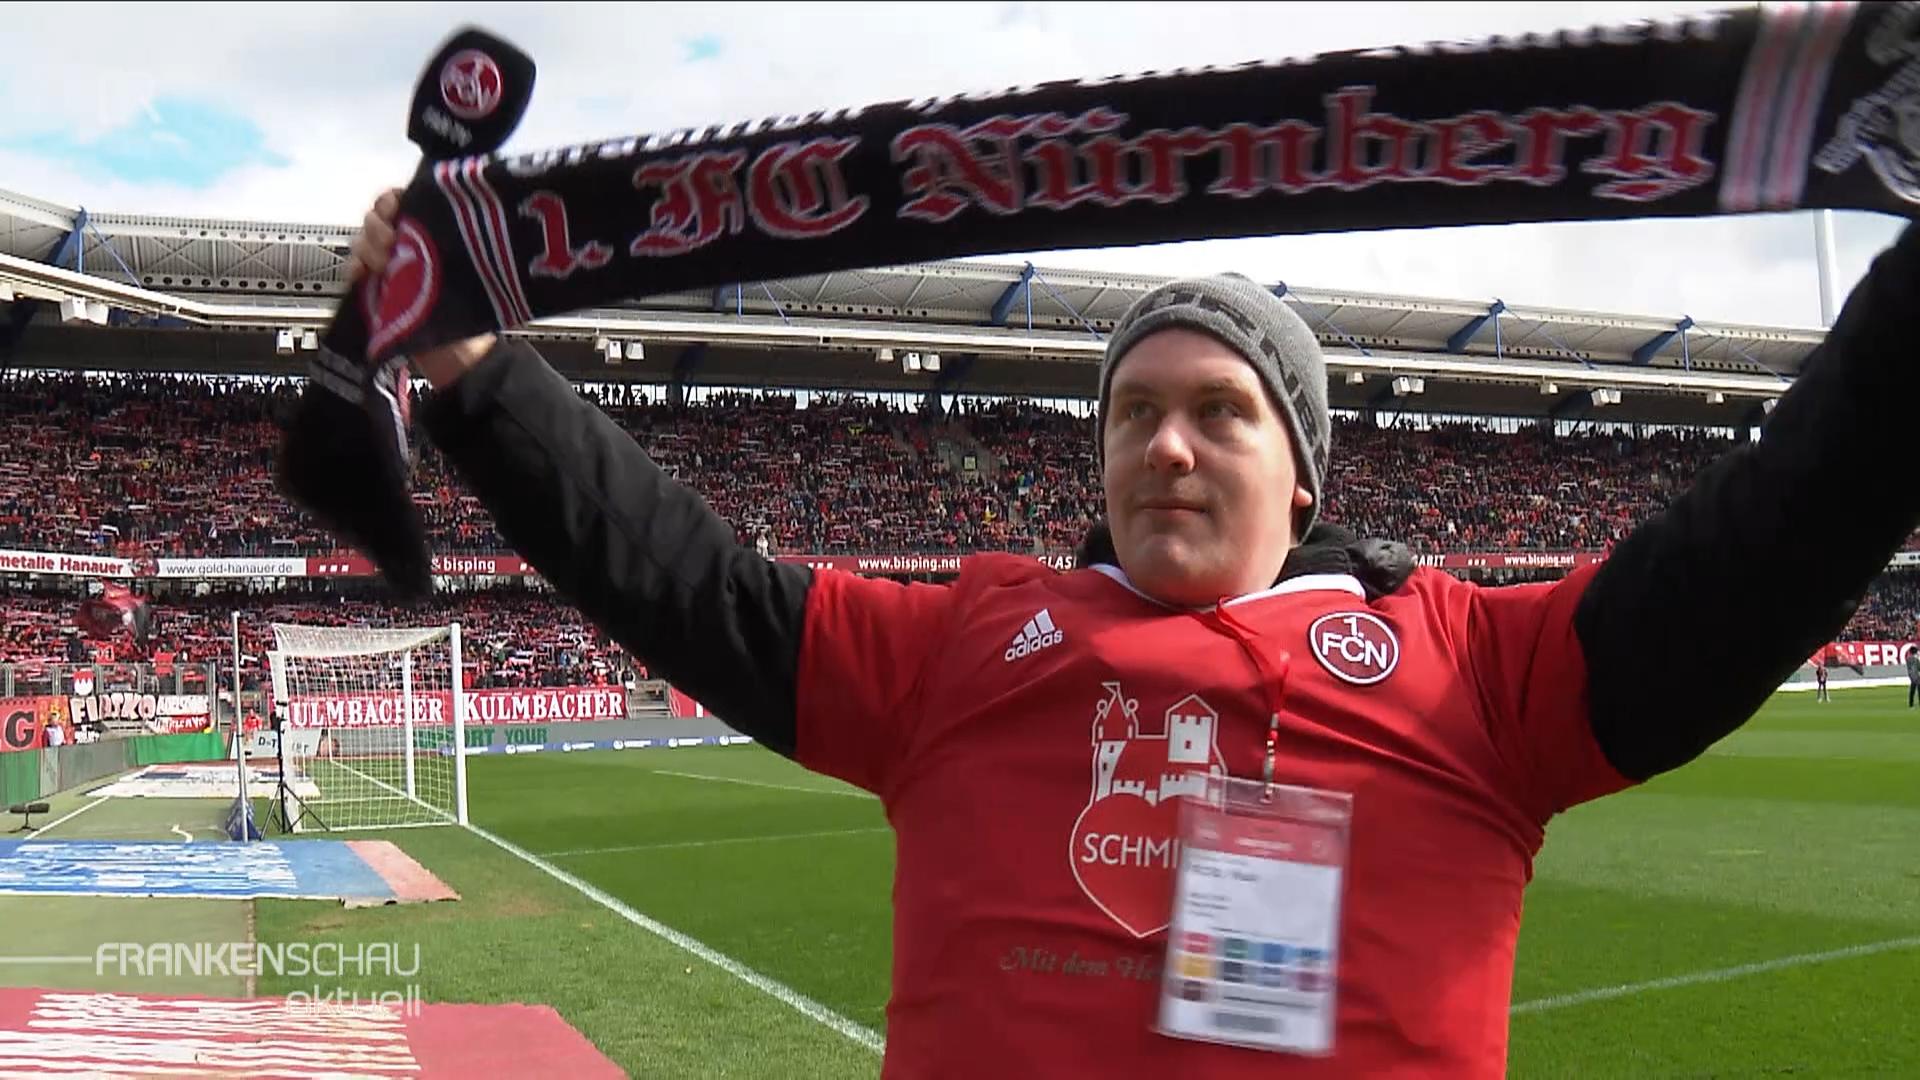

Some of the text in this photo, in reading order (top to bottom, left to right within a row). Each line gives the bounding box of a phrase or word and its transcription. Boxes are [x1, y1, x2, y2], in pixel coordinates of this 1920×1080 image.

[518, 191, 613, 279] 1.
[630, 136, 870, 258] FC
[891, 85, 1717, 222] Nürnberg
[60, 557, 123, 575] Hanauer
[166, 562, 293, 574] www.gold-hanauer.de
[443, 557, 496, 573] bisping
[858, 555, 961, 571] www.bisping.net
[1504, 553, 1575, 566] www.bisping.net
[1004, 629, 1063, 662] adidas
[1321, 632, 1389, 670] FCN
[463, 691, 623, 721] KULMBACHER
[1081, 833, 1180, 868] SCHMI
